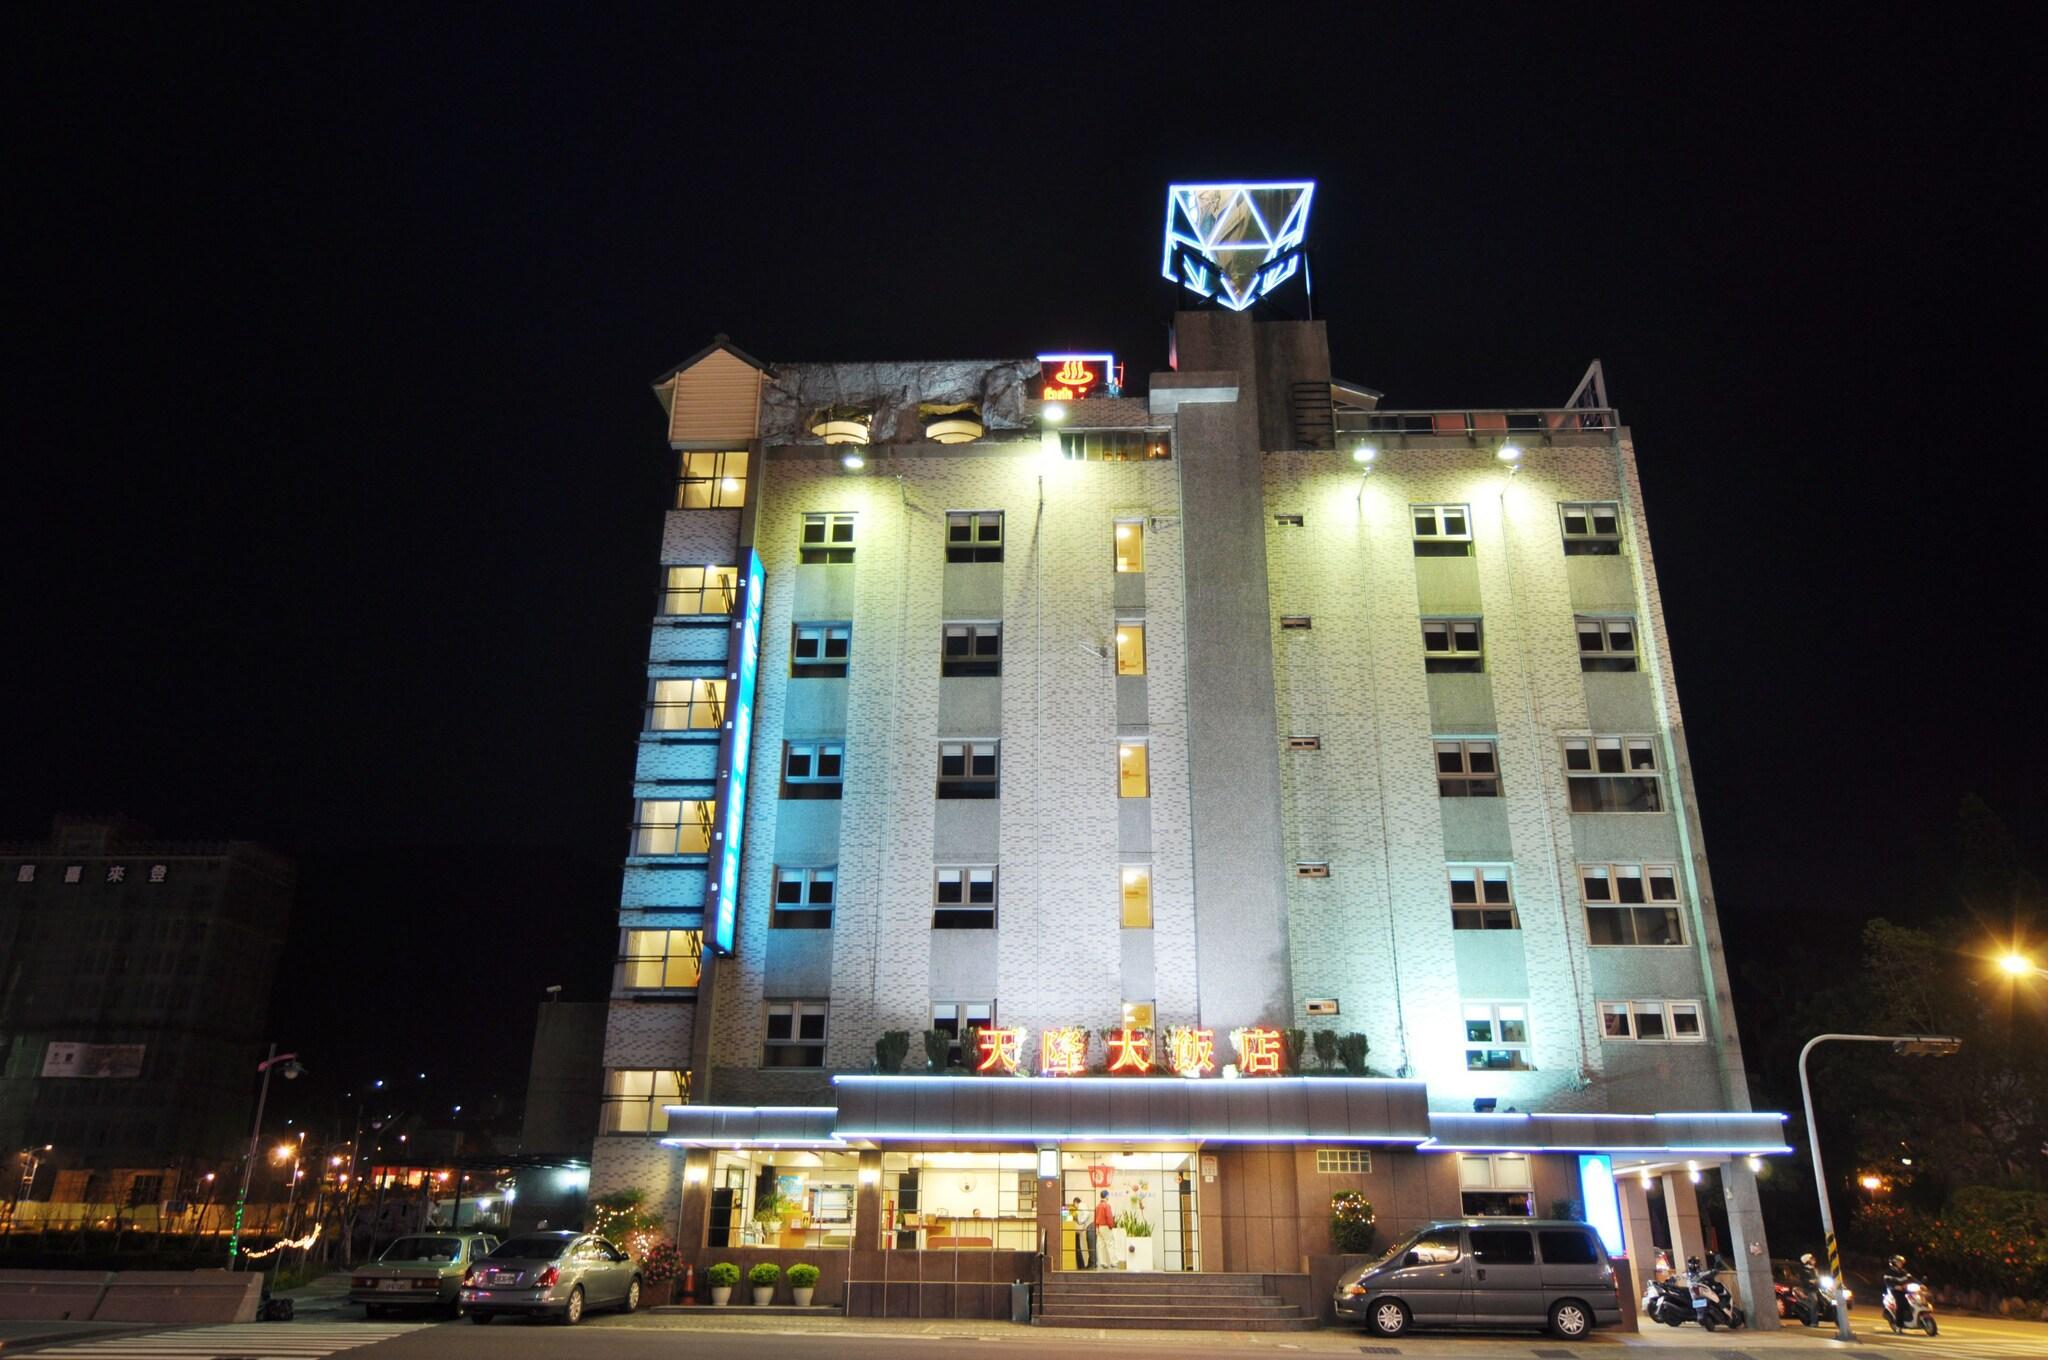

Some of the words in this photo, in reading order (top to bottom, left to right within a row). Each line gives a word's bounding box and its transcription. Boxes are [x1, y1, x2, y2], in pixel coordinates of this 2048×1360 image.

[978, 1028, 1281, 1073] 天隆大飯店
